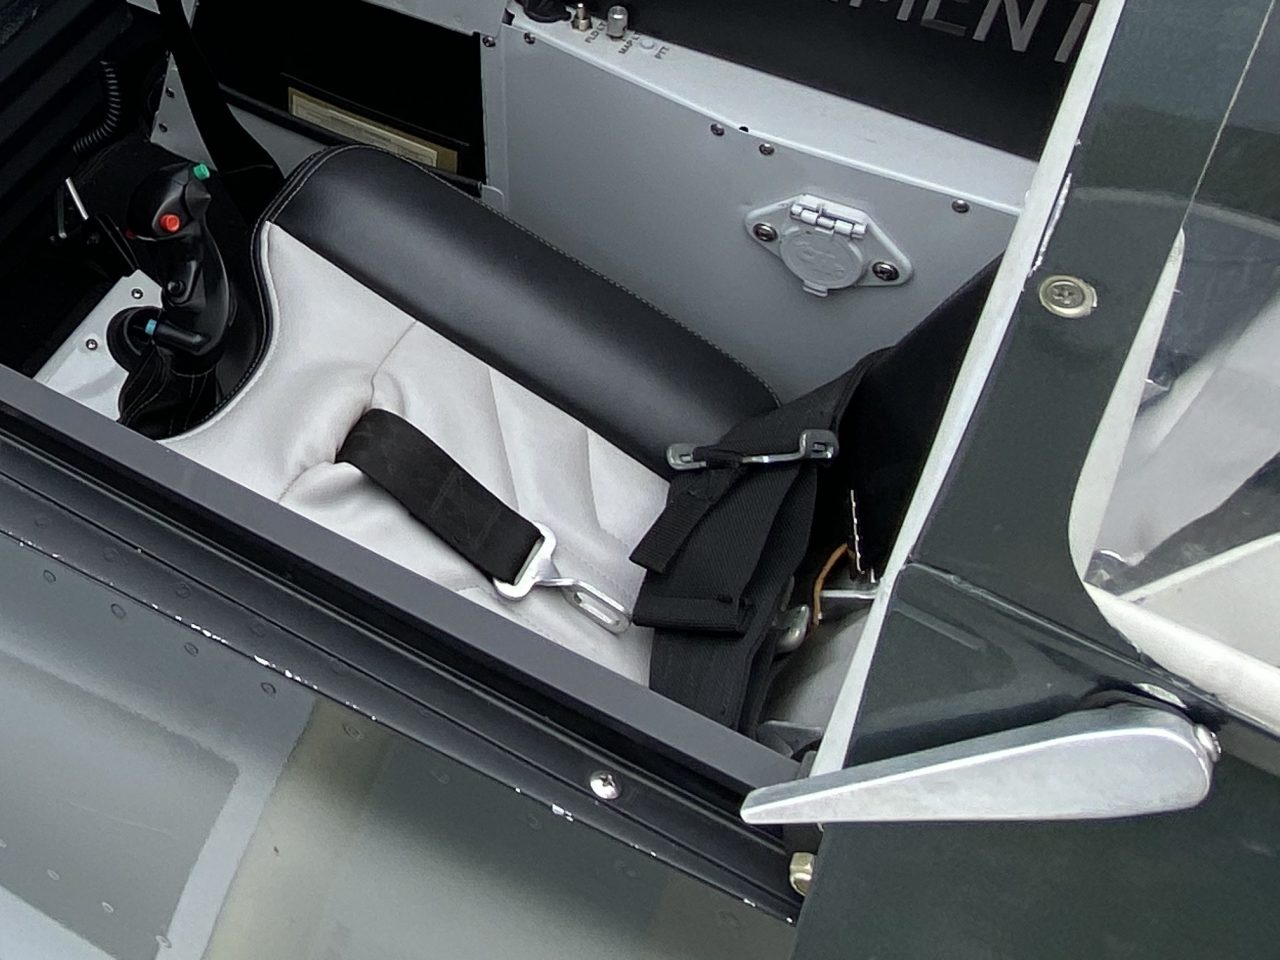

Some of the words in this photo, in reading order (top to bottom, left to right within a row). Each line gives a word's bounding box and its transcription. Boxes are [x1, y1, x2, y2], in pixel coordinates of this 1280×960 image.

[585, 31, 600, 44] FLD
[618, 39, 633, 55] MAP
[654, 46, 670, 60] PTT
